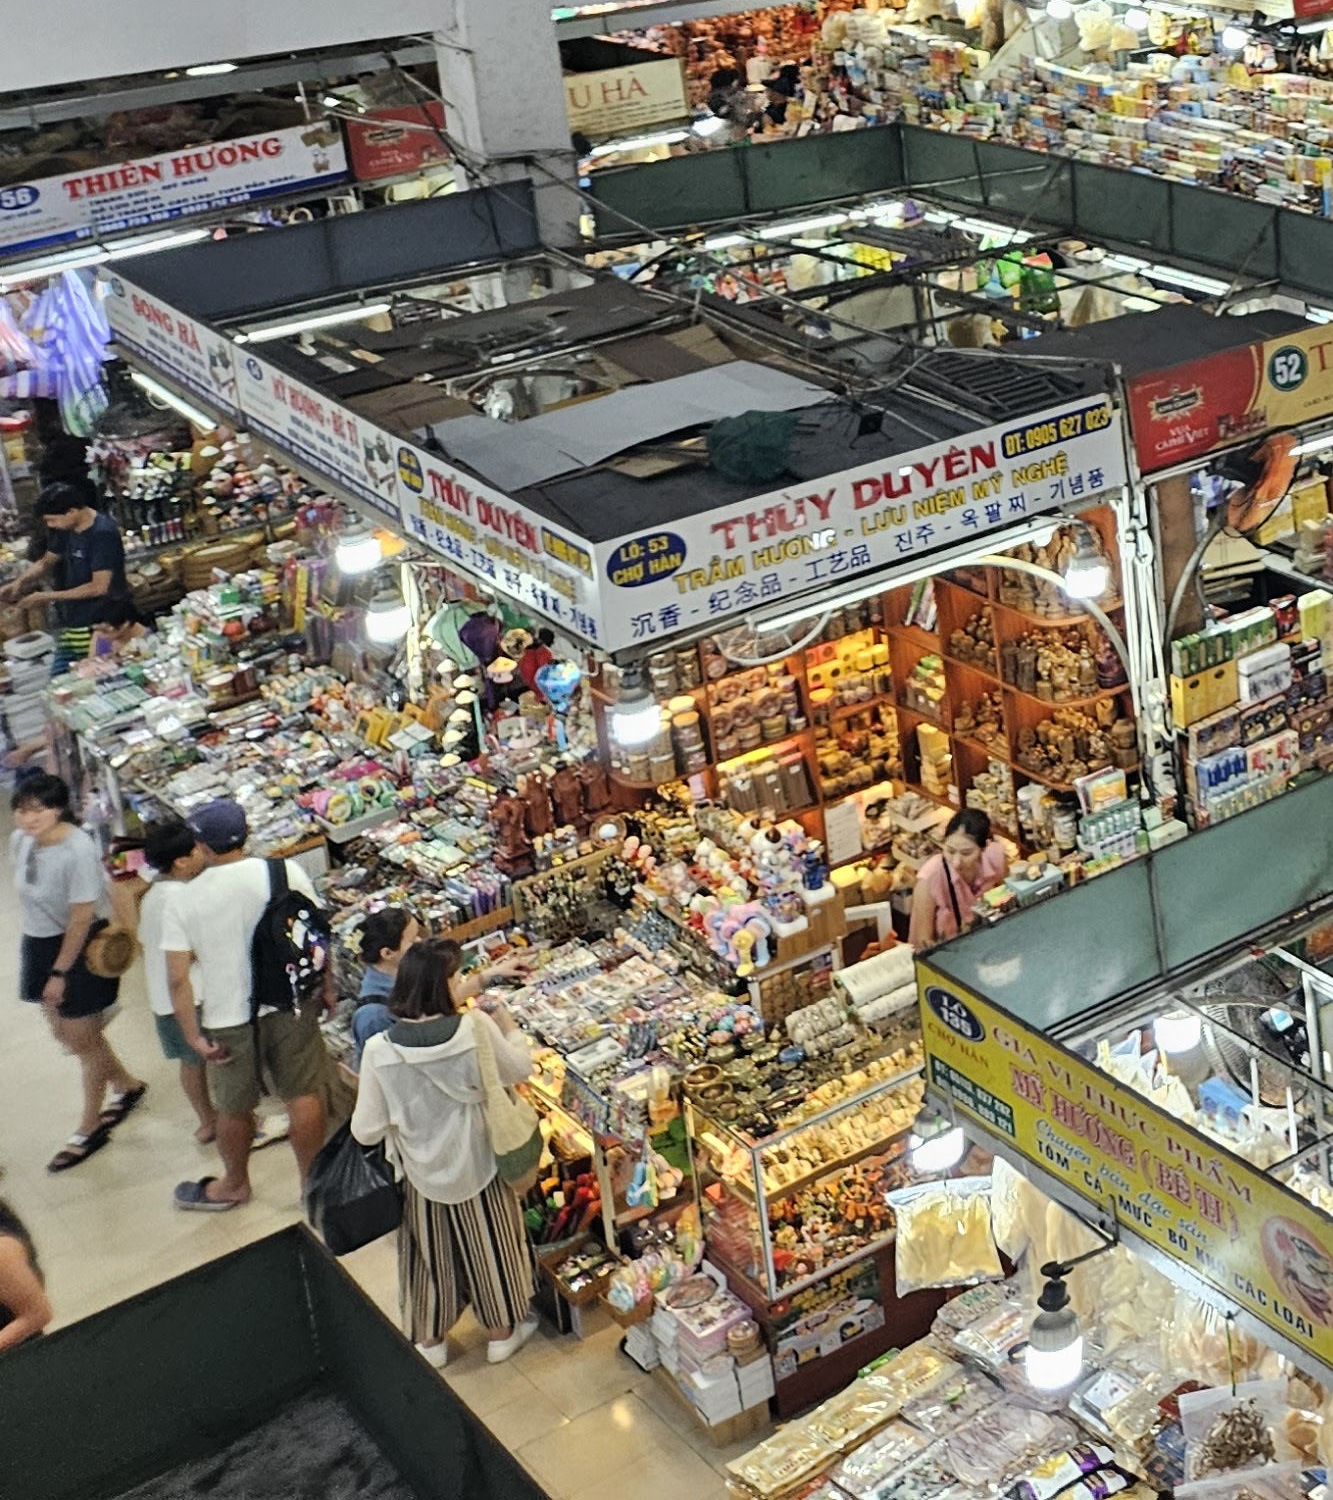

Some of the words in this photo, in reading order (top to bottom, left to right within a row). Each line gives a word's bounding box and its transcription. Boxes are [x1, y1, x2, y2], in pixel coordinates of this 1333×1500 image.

[63, 163, 162, 200] THIÊN
[172, 138, 282, 177] HƯƠNG
[1272, 353, 1303, 382] 52
[1026, 422, 1058, 448] 0905
[1059, 415, 1082, 435] 627
[1085, 405, 1111, 430] 023
[710, 486, 836, 551] THÙY
[851, 440, 997, 510] DUYÊN
[861, 504, 908, 537] LƯU
[913, 486, 966, 517] NIỆM
[972, 473, 1004, 500] MỸ
[1011, 450, 1069, 487] NGHỆ
[620, 537, 646, 562] LÔ:
[648, 536, 669, 553] 53
[895, 523, 935, 552] 진주
[612, 562, 644, 587] CHỢ
[650, 553, 682, 575] HÀN
[631, 603, 682, 638] 沉香
[708, 572, 782, 615] 纪念品
[805, 545, 872, 582] 工艺品
[993, 1027, 1037, 1065] GIA
[1166, 1137, 1253, 1204] PHẨM
[1035, 1139, 1071, 1174] TÔM
